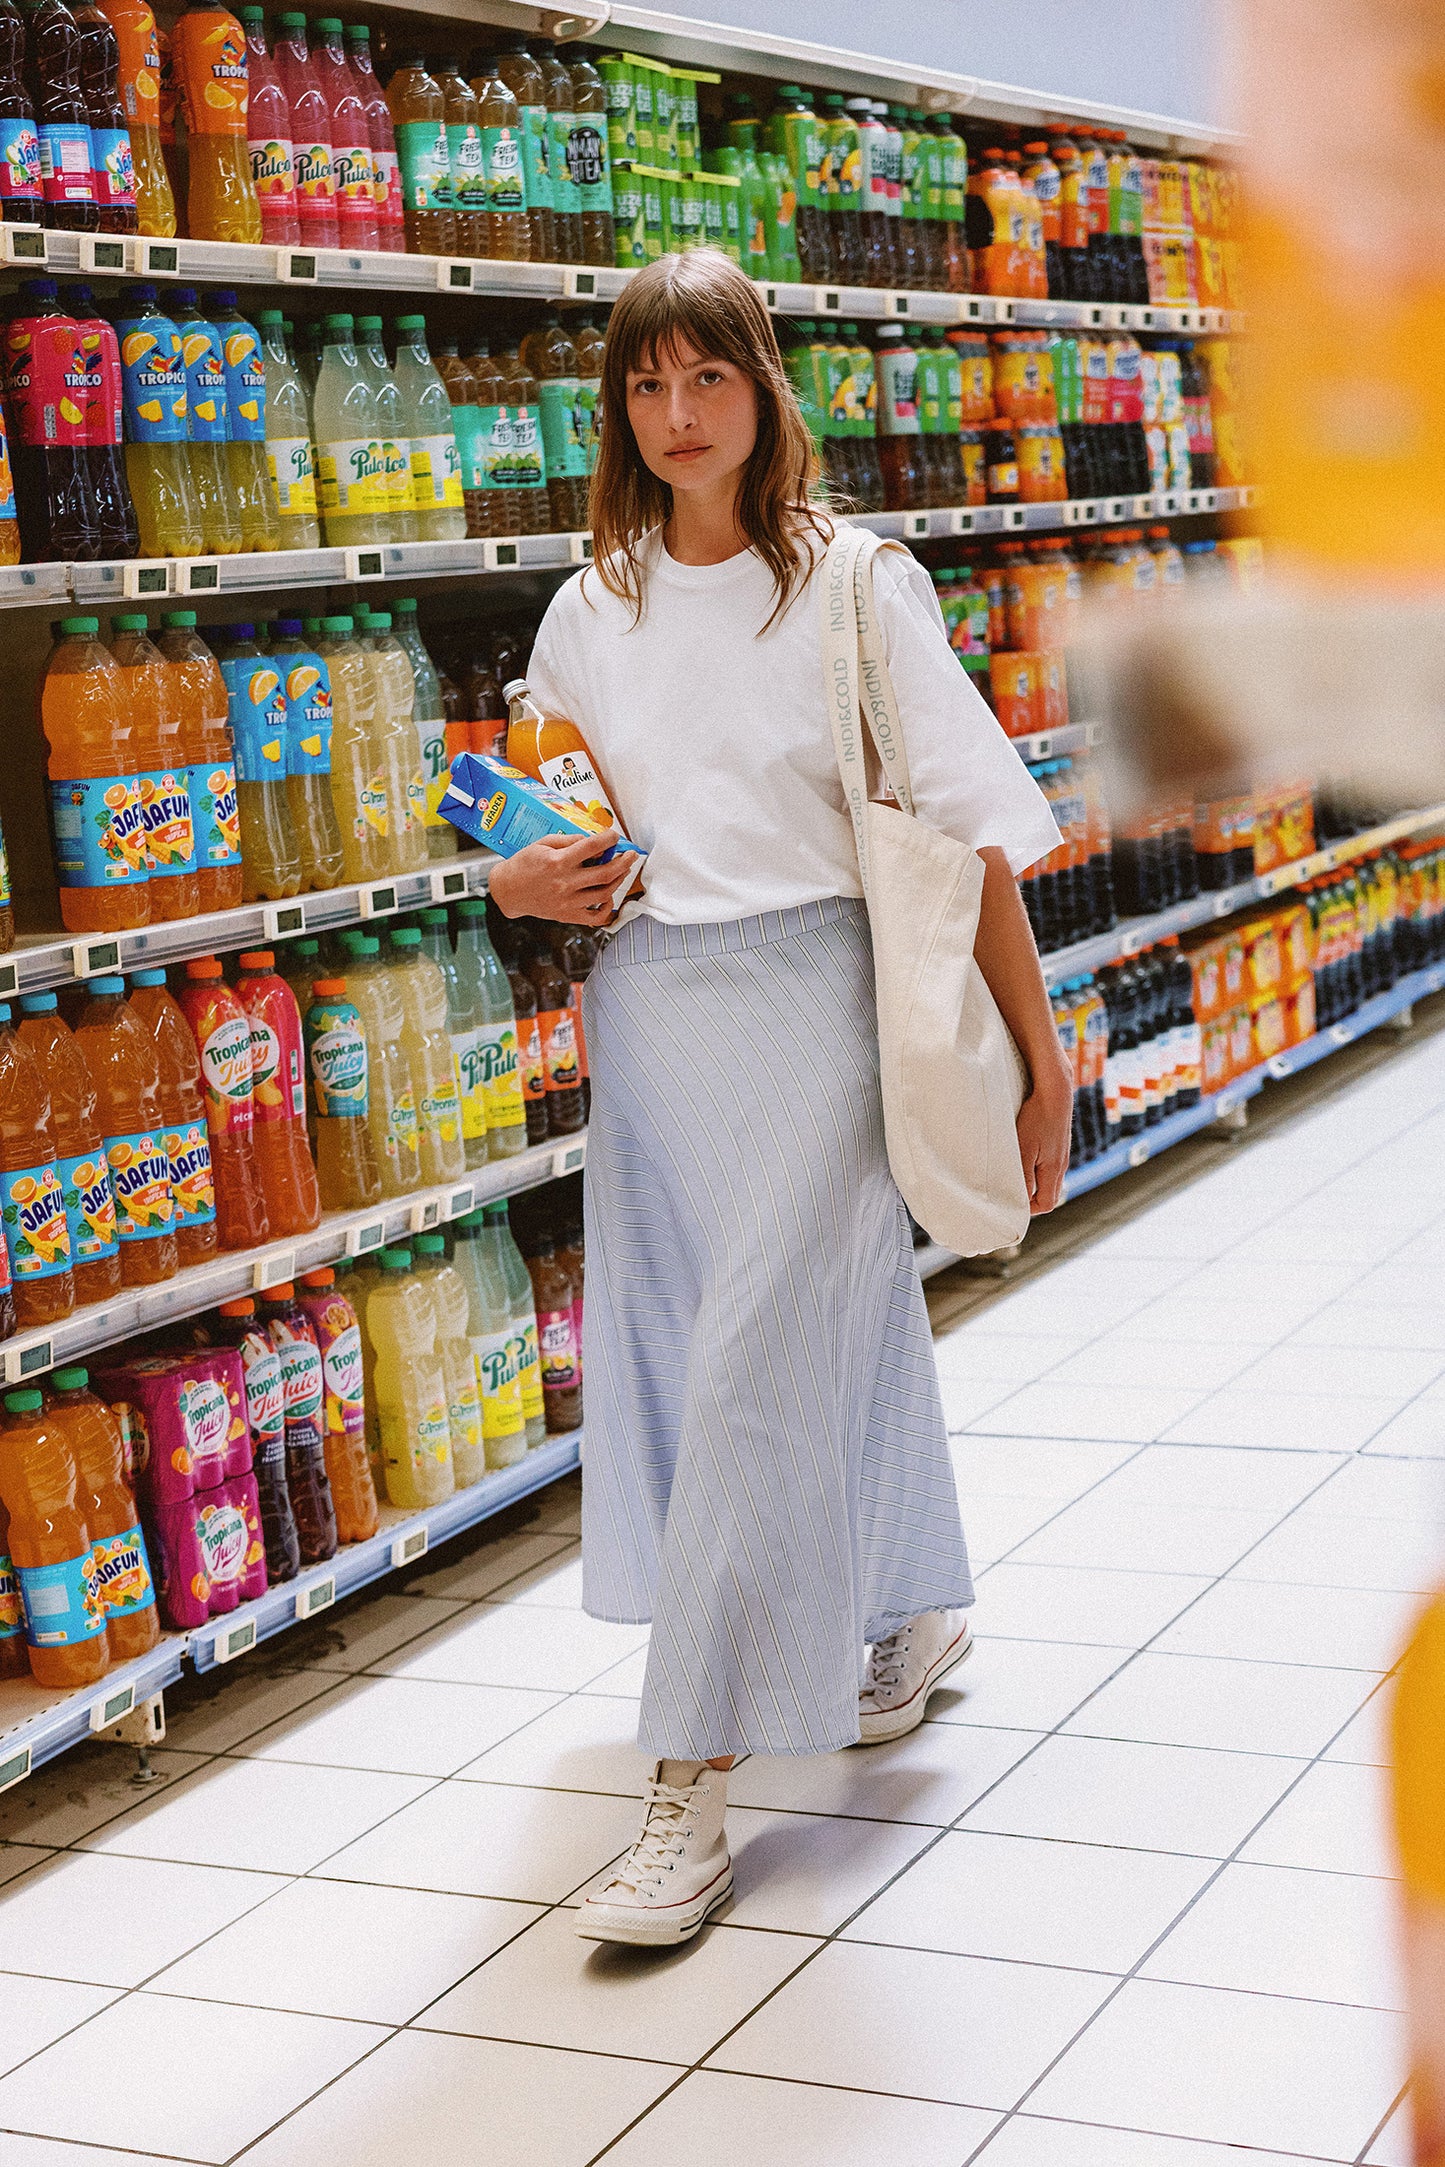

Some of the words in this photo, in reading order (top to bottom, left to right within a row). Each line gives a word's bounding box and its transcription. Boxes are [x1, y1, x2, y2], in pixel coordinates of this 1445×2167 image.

[833, 658, 855, 762] INDI&COLD
[861, 659, 896, 762] INDI&COLD
[552, 769, 594, 792] Pauline
[141, 794, 190, 832] JAFUN
[484, 794, 504, 828] JAFADEN
[115, 1155, 168, 1196] JAFUN
[96, 1549, 140, 1585] JAFUN
